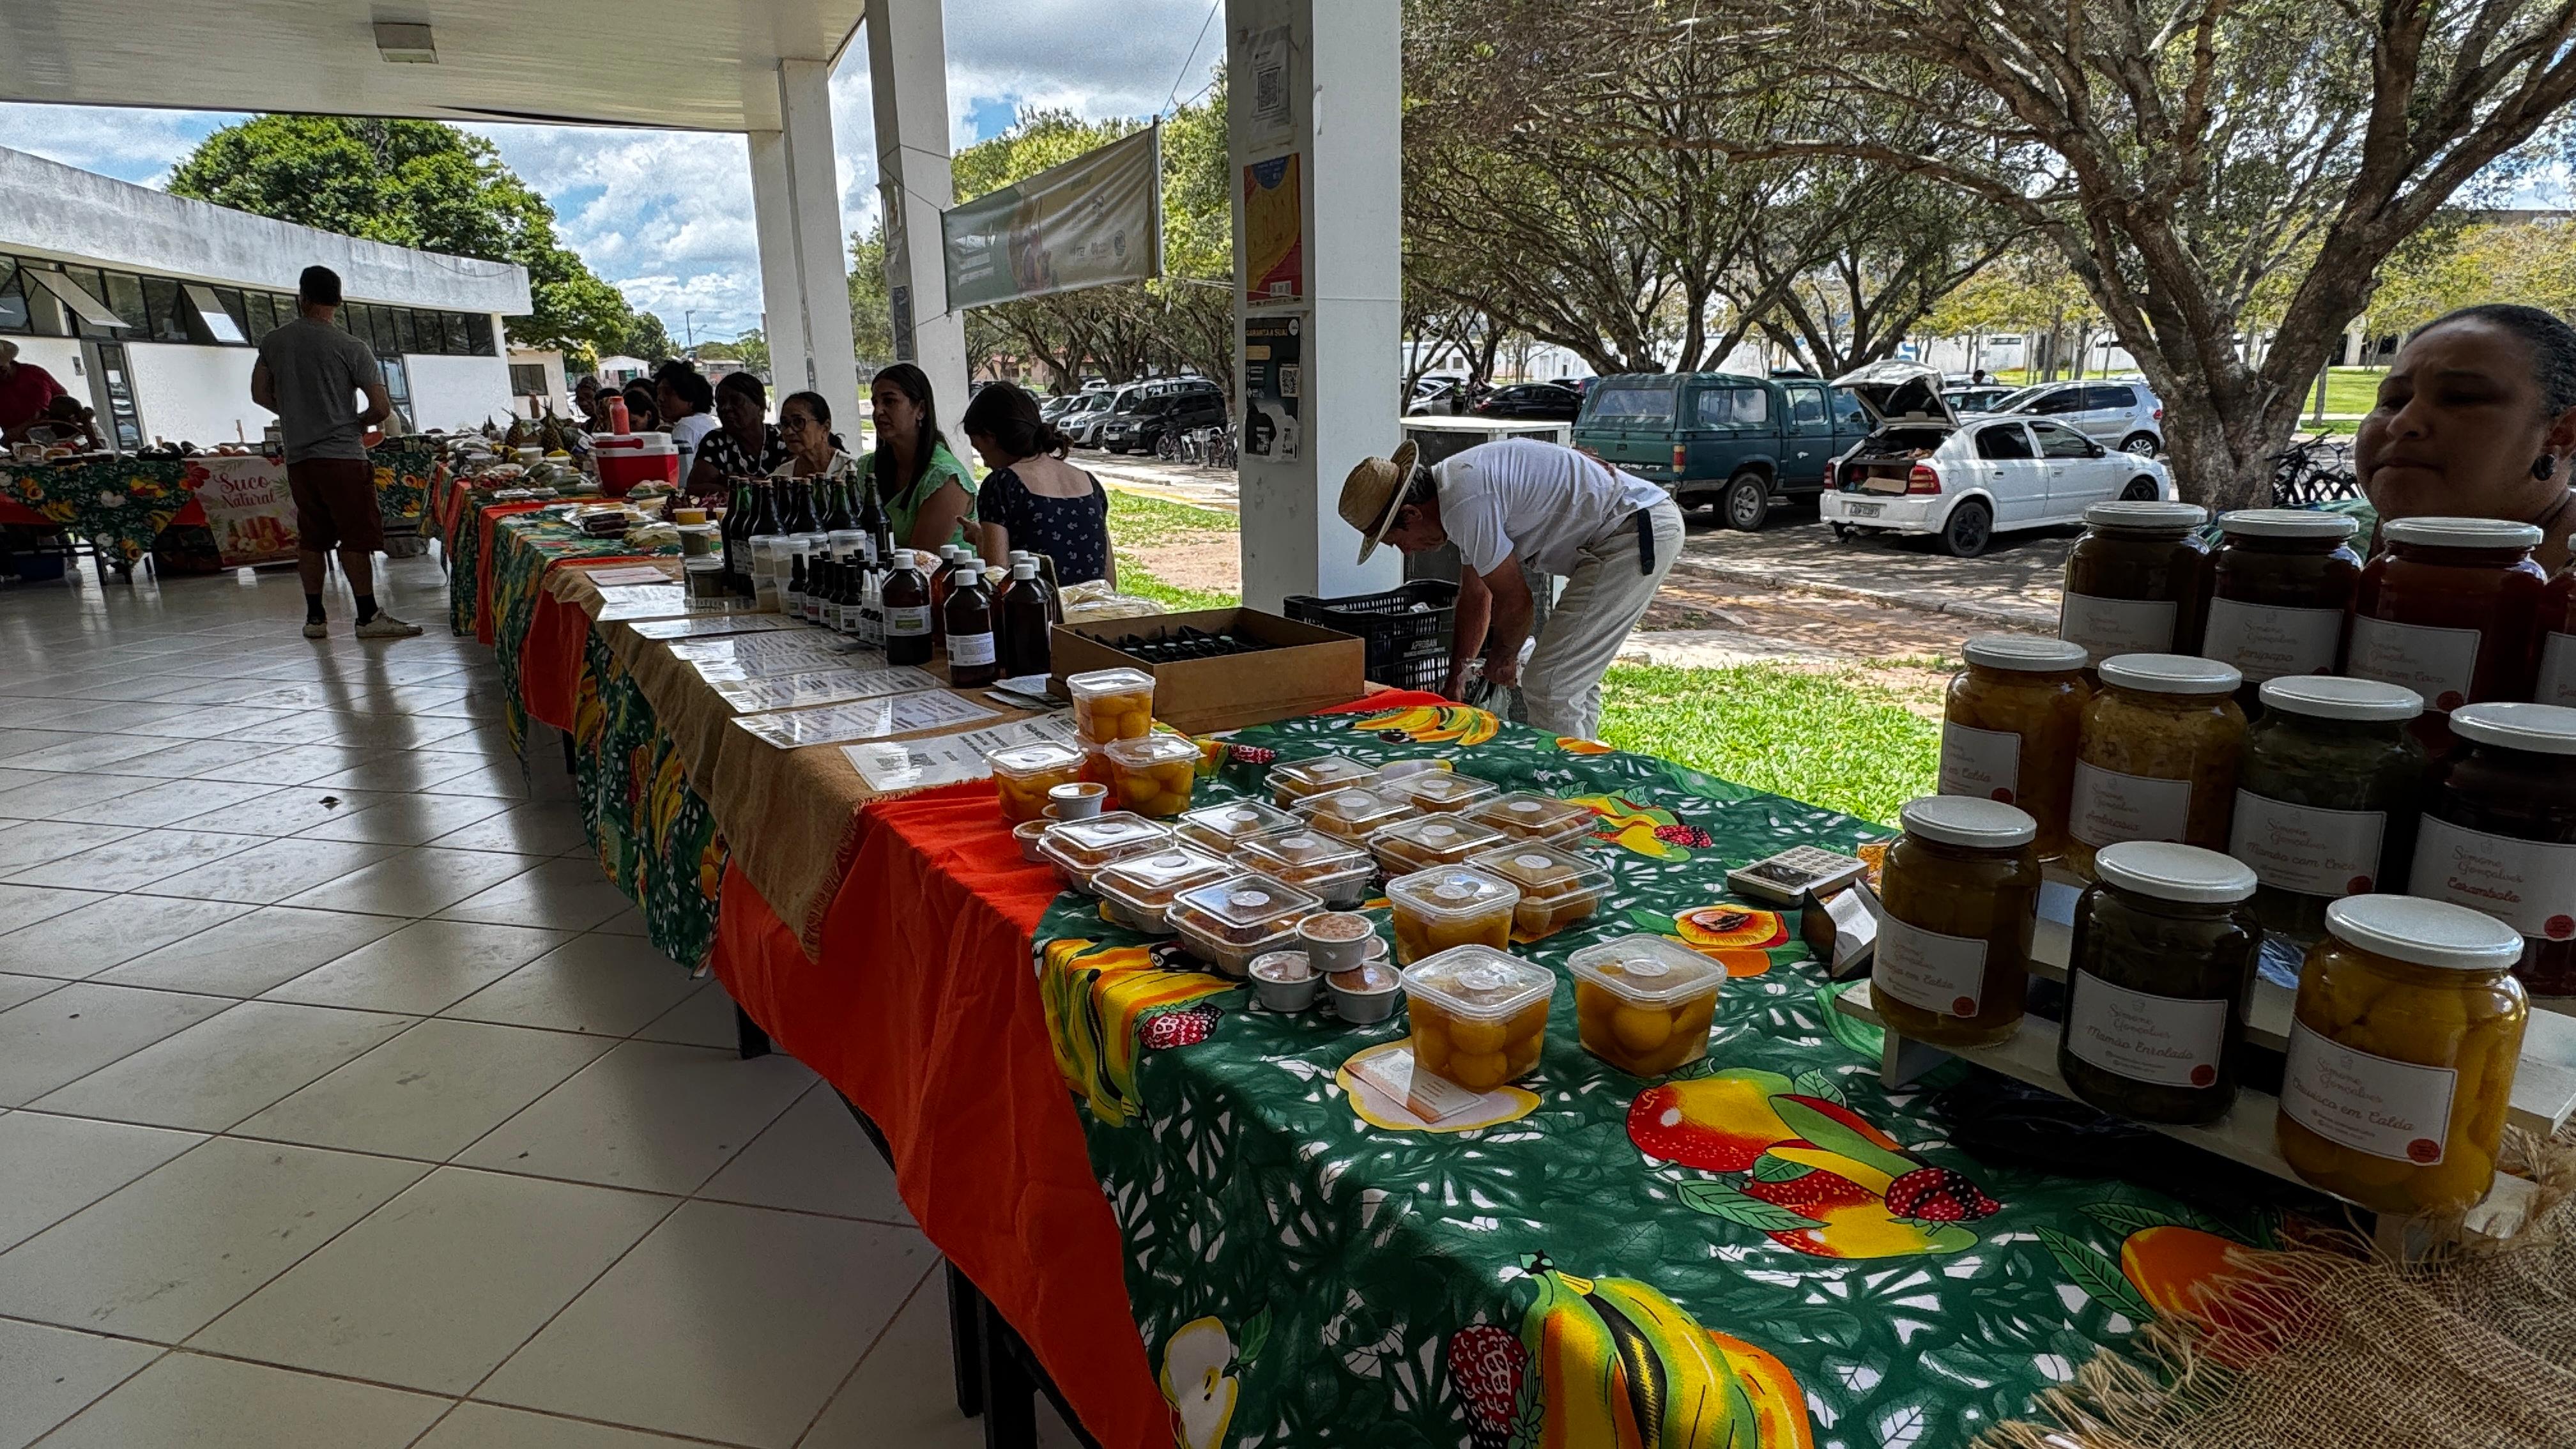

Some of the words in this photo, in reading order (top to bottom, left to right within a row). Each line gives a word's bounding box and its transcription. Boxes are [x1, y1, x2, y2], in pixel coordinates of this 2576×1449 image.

[213, 472, 270, 494] Suco
[221, 488, 277, 509] Natural
[2235, 646, 2294, 663] Jenipapo
[2265, 818, 2308, 836] Simone
[2246, 841, 2289, 862] Mamão
[2292, 858, 2320, 868] com
[2452, 845, 2503, 868] Simone
[2458, 860, 2525, 884] Gonçalves
[2447, 877, 2522, 903] Carambola
[1923, 973, 1955, 990] Calda
[2108, 1003, 2153, 1025] Simone
[2086, 1025, 2131, 1048] Mamão
[2135, 1041, 2194, 1059] Enrolado
[2315, 1056, 2363, 1085] Simone
[2319, 1072, 2384, 1104] Gonçalves
[2340, 1105, 2363, 1119] em
[2368, 1110, 2414, 1131] Calda
